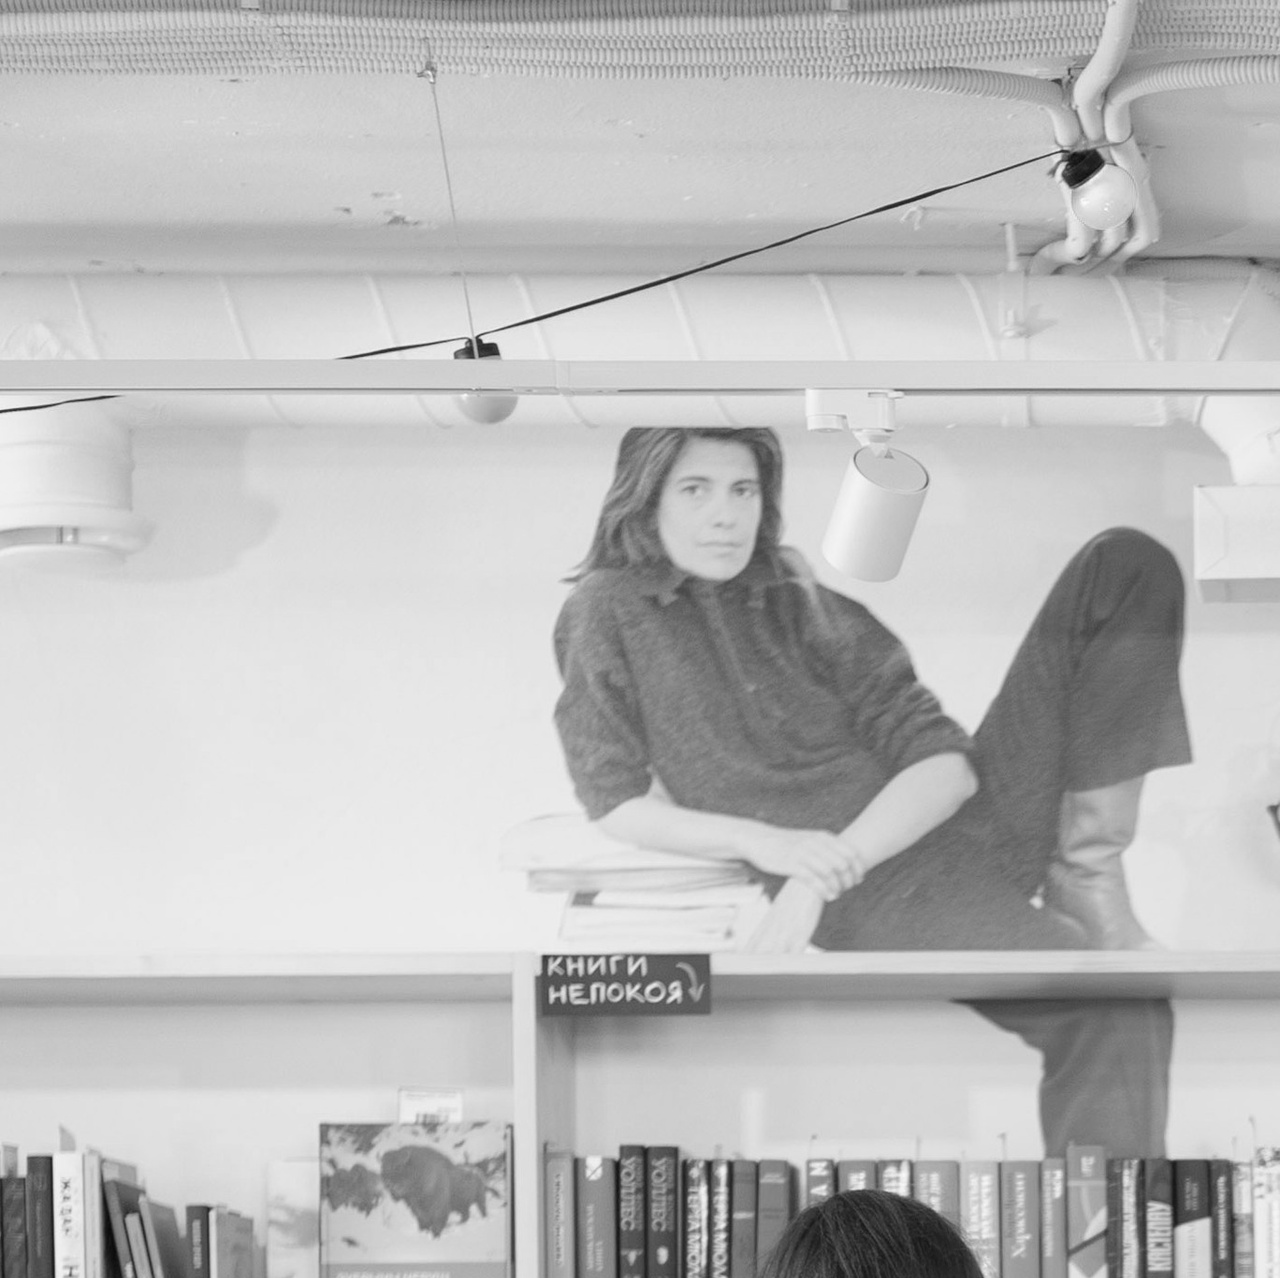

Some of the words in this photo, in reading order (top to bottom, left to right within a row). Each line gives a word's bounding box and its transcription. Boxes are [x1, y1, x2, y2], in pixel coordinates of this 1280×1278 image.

[547, 955, 648, 977] КНИГИ
[548, 980, 684, 1005] НЕПОКОЯ
[620, 1156, 636, 1231] УОЛЛЕС
[650, 1157, 667, 1232] УОЛЛЕС
[1147, 1200, 1173, 1271] КАСТЕЛАУ
